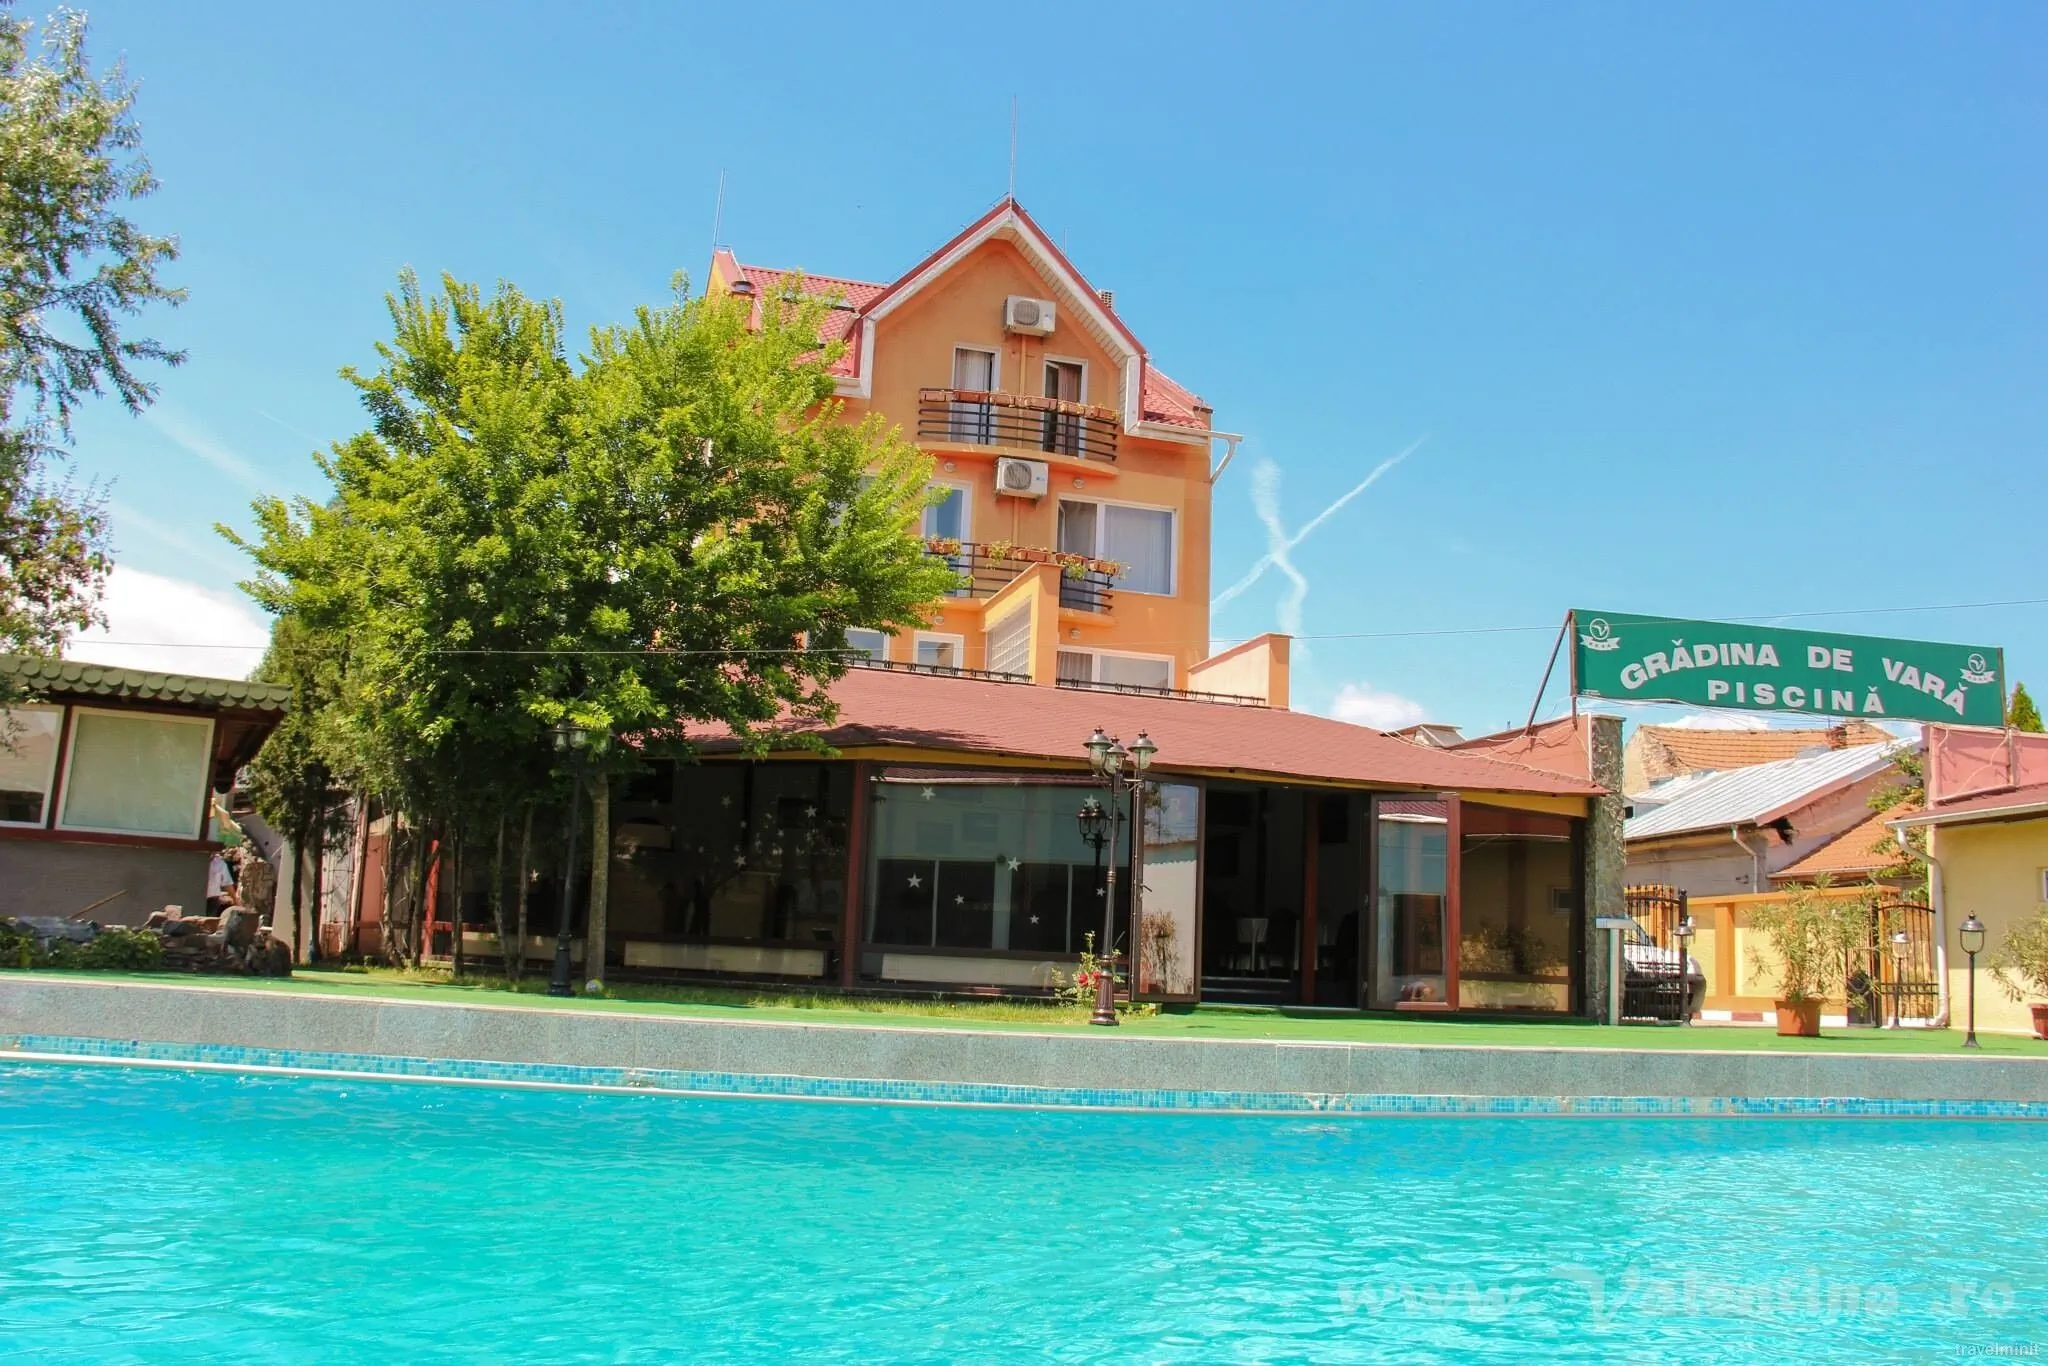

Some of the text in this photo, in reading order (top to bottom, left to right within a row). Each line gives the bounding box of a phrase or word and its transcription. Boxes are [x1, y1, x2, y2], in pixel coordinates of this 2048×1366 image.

[1620, 638, 1968, 716] GRĂDINA DE VARĂ
[1707, 679, 1885, 714] PISCINĂ
